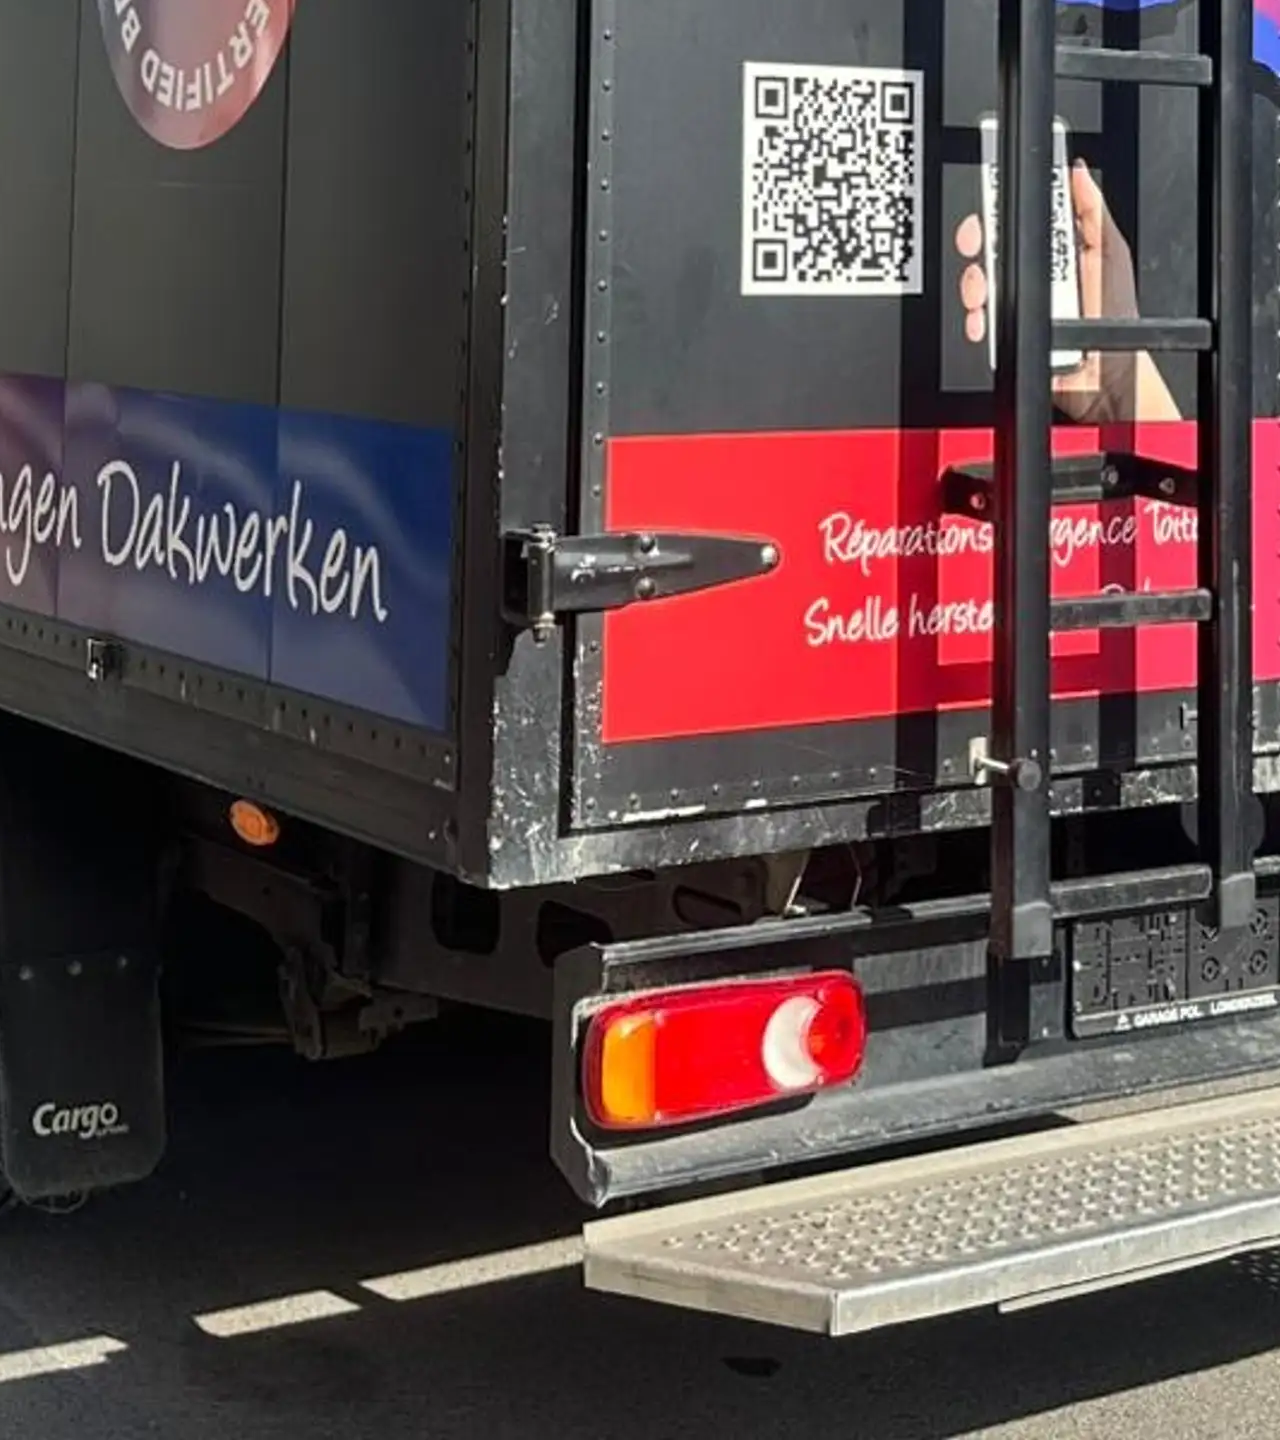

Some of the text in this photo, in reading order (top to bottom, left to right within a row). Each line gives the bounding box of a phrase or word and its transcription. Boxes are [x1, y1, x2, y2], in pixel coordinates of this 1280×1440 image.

[95, 458, 389, 626] Dakwerken
[803, 594, 900, 647] Snelle
[32, 1101, 119, 1140] Cargo
